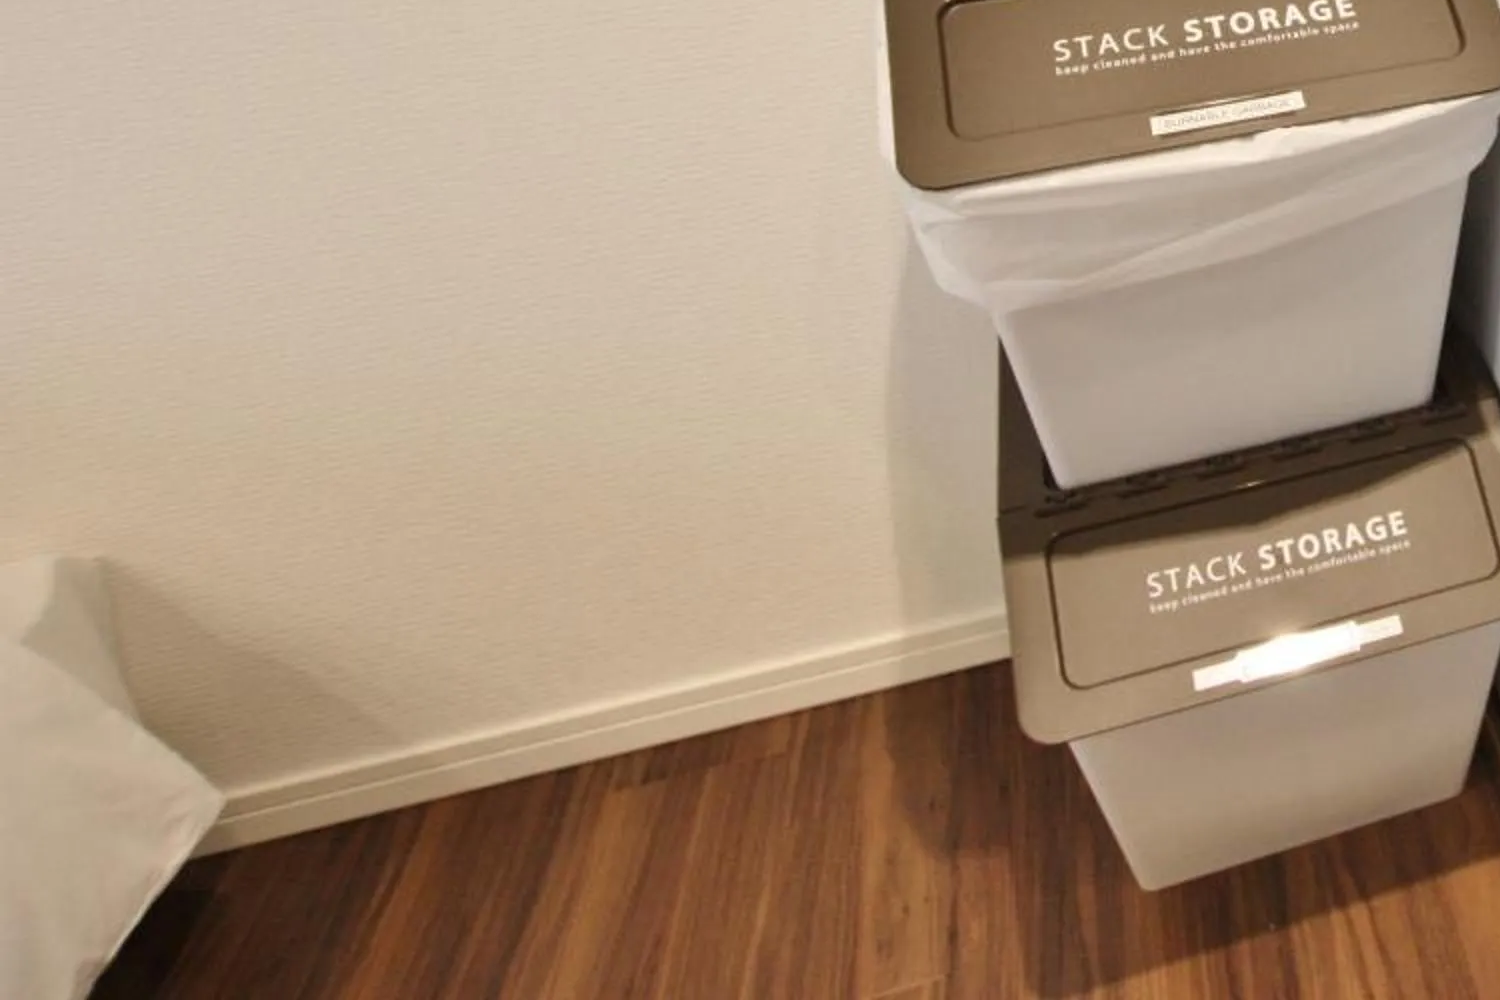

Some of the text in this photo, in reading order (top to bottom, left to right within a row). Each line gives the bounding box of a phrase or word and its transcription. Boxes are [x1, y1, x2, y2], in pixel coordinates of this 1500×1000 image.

[1053, 23, 1169, 62] STACK
[1055, 20, 1360, 76] keep cleaned and have the comfortable space
[1146, 510, 1409, 599] STACK STORAGE
[1231, 578, 1252, 593] and
[1285, 566, 1305, 578] the
